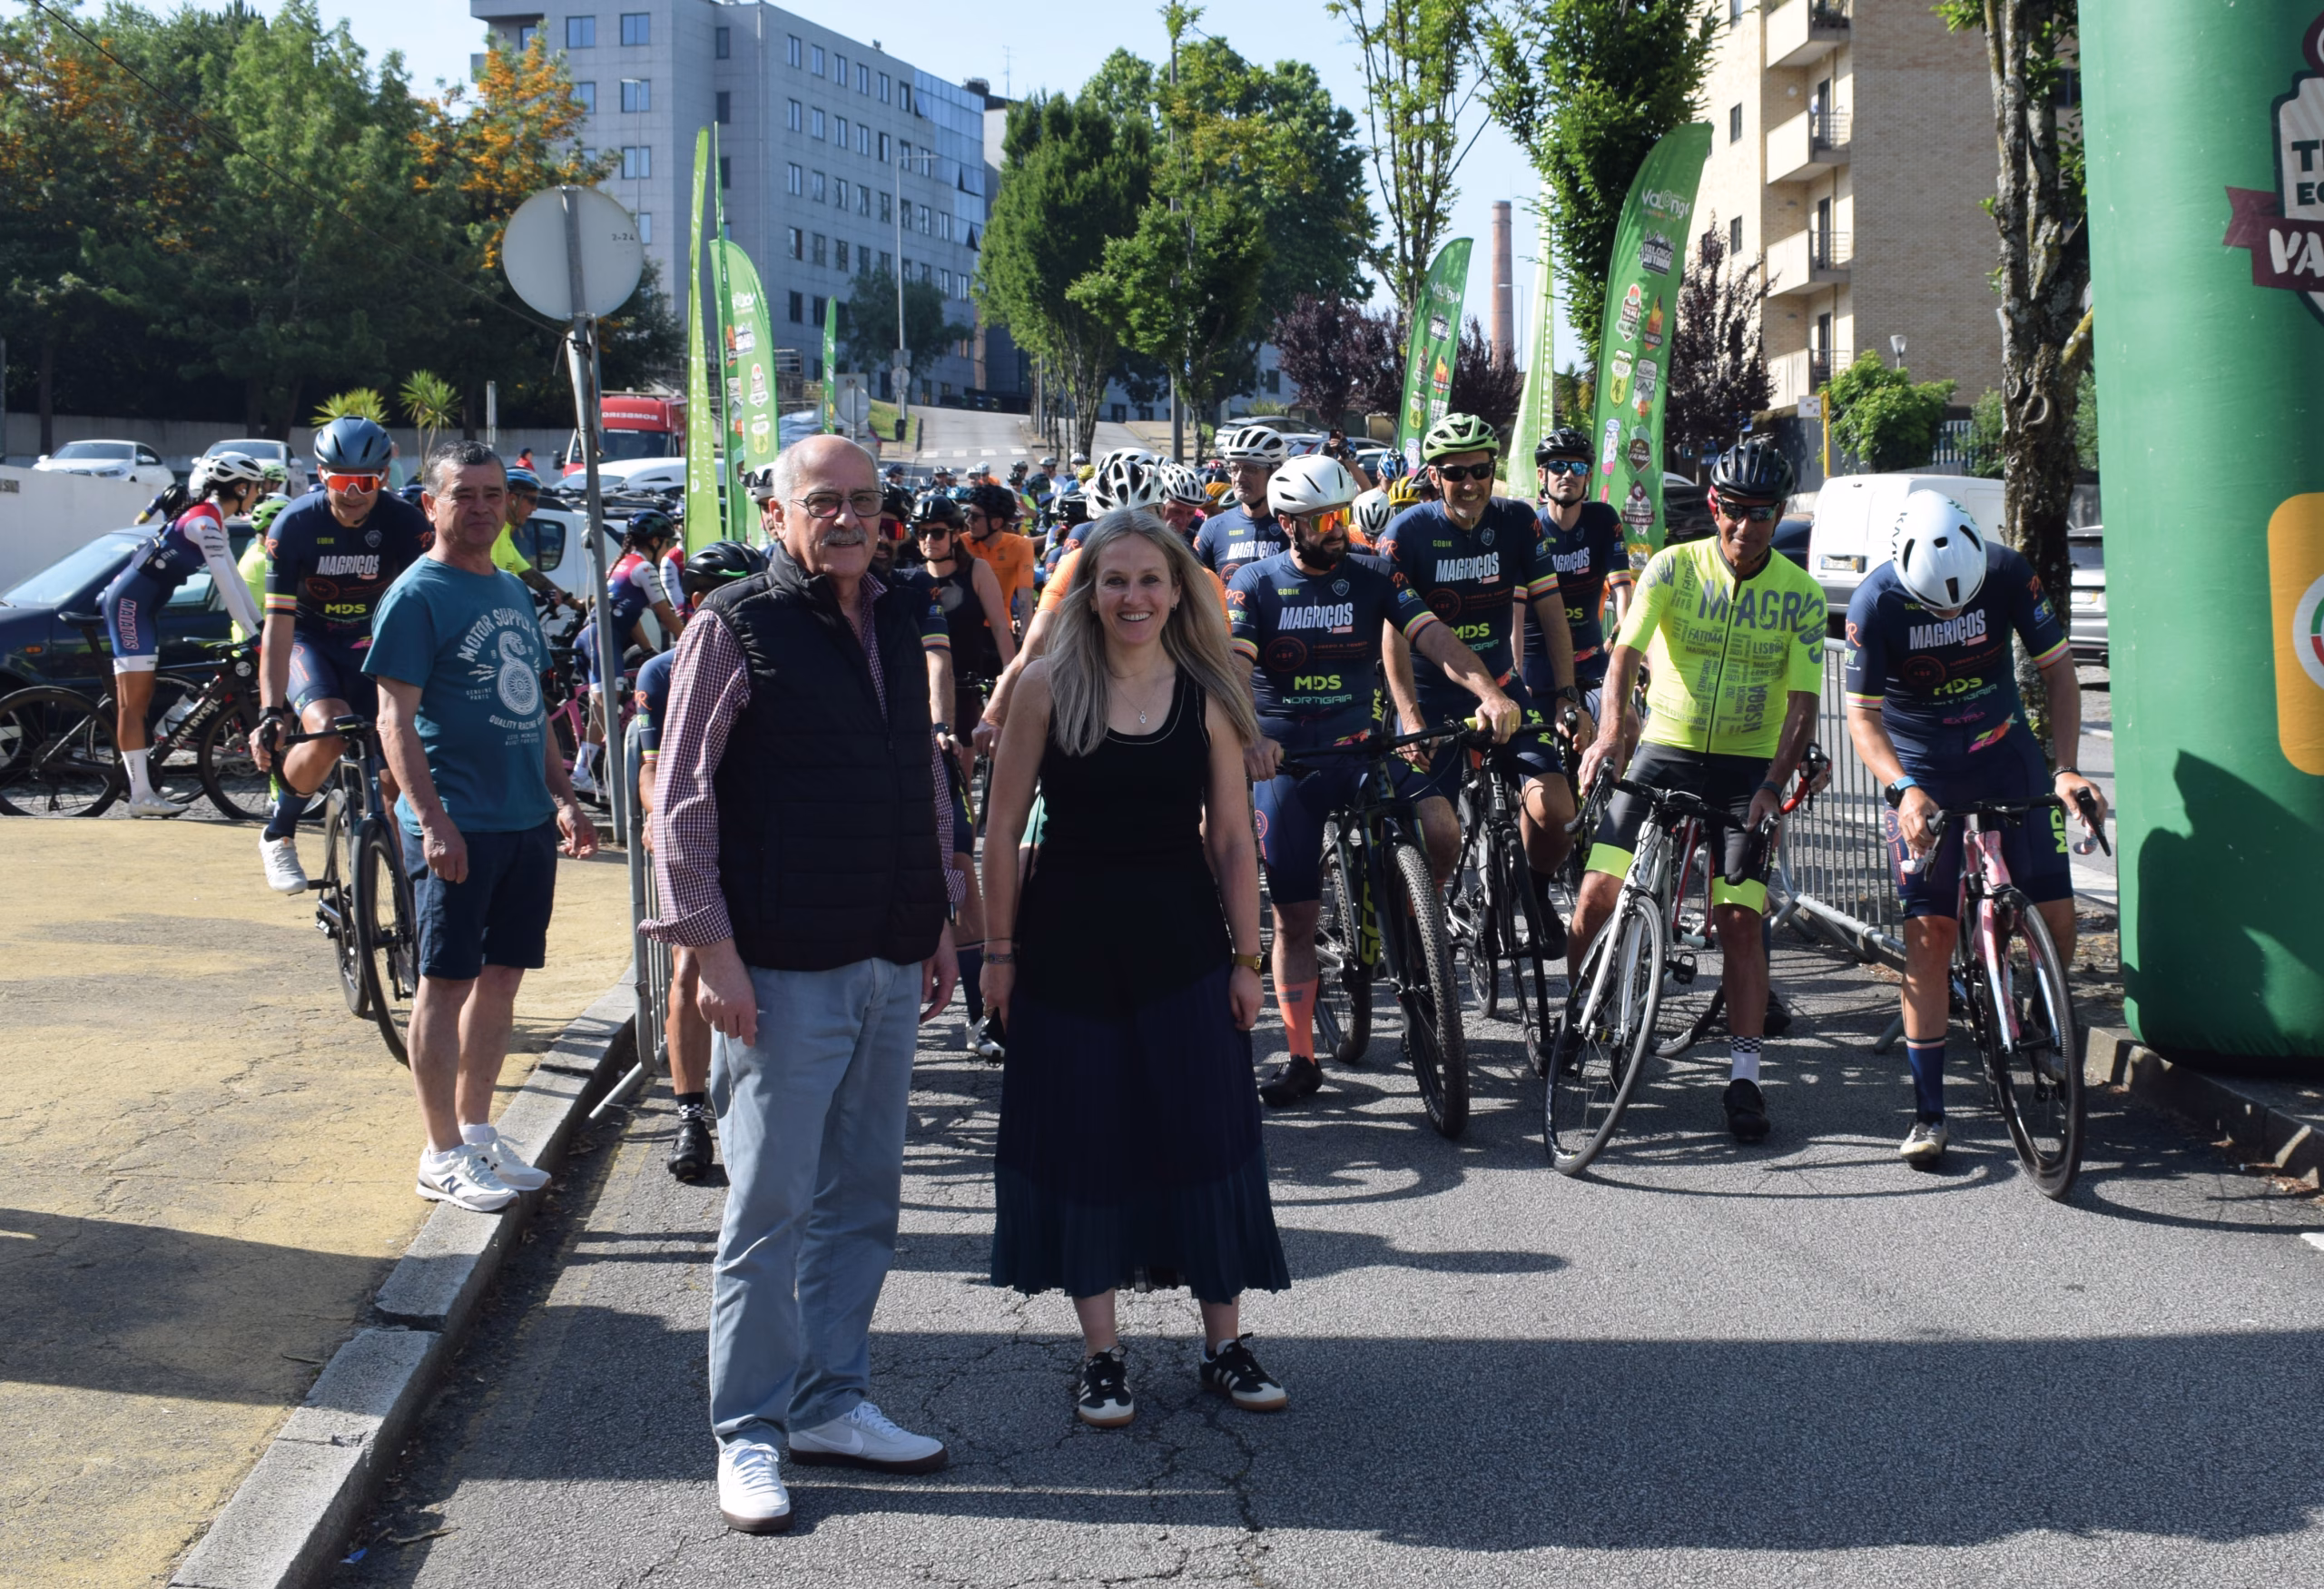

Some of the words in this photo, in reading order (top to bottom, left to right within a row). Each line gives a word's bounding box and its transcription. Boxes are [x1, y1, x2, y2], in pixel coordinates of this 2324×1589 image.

[2291, 139, 2324, 173] T
[316, 555, 379, 578] MAGRIÇOS
[1435, 551, 1500, 584] MAGRIÇOS
[118, 598, 139, 650] MAIATOS
[324, 603, 367, 615] MDS
[1277, 602, 1354, 633] MAGRIÇOS
[458, 615, 496, 663] MOTOR
[492, 607, 530, 633] SUPPLY
[1689, 627, 1723, 645] FÁTIMA
[1909, 608, 1986, 650] MAGRIÇOS
[1686, 646, 1720, 657] MAGRIÇOS
[466, 687, 492, 696] GENUINE
[1294, 675, 1342, 690] MDS
[1933, 677, 1983, 696] MDS
[1372, 688, 1383, 722] MDS
[170, 725, 193, 748] VAN
[190, 698, 222, 725] RYSEL
[488, 715, 517, 729] QUALITY
[1491, 773, 1506, 810] BMC
